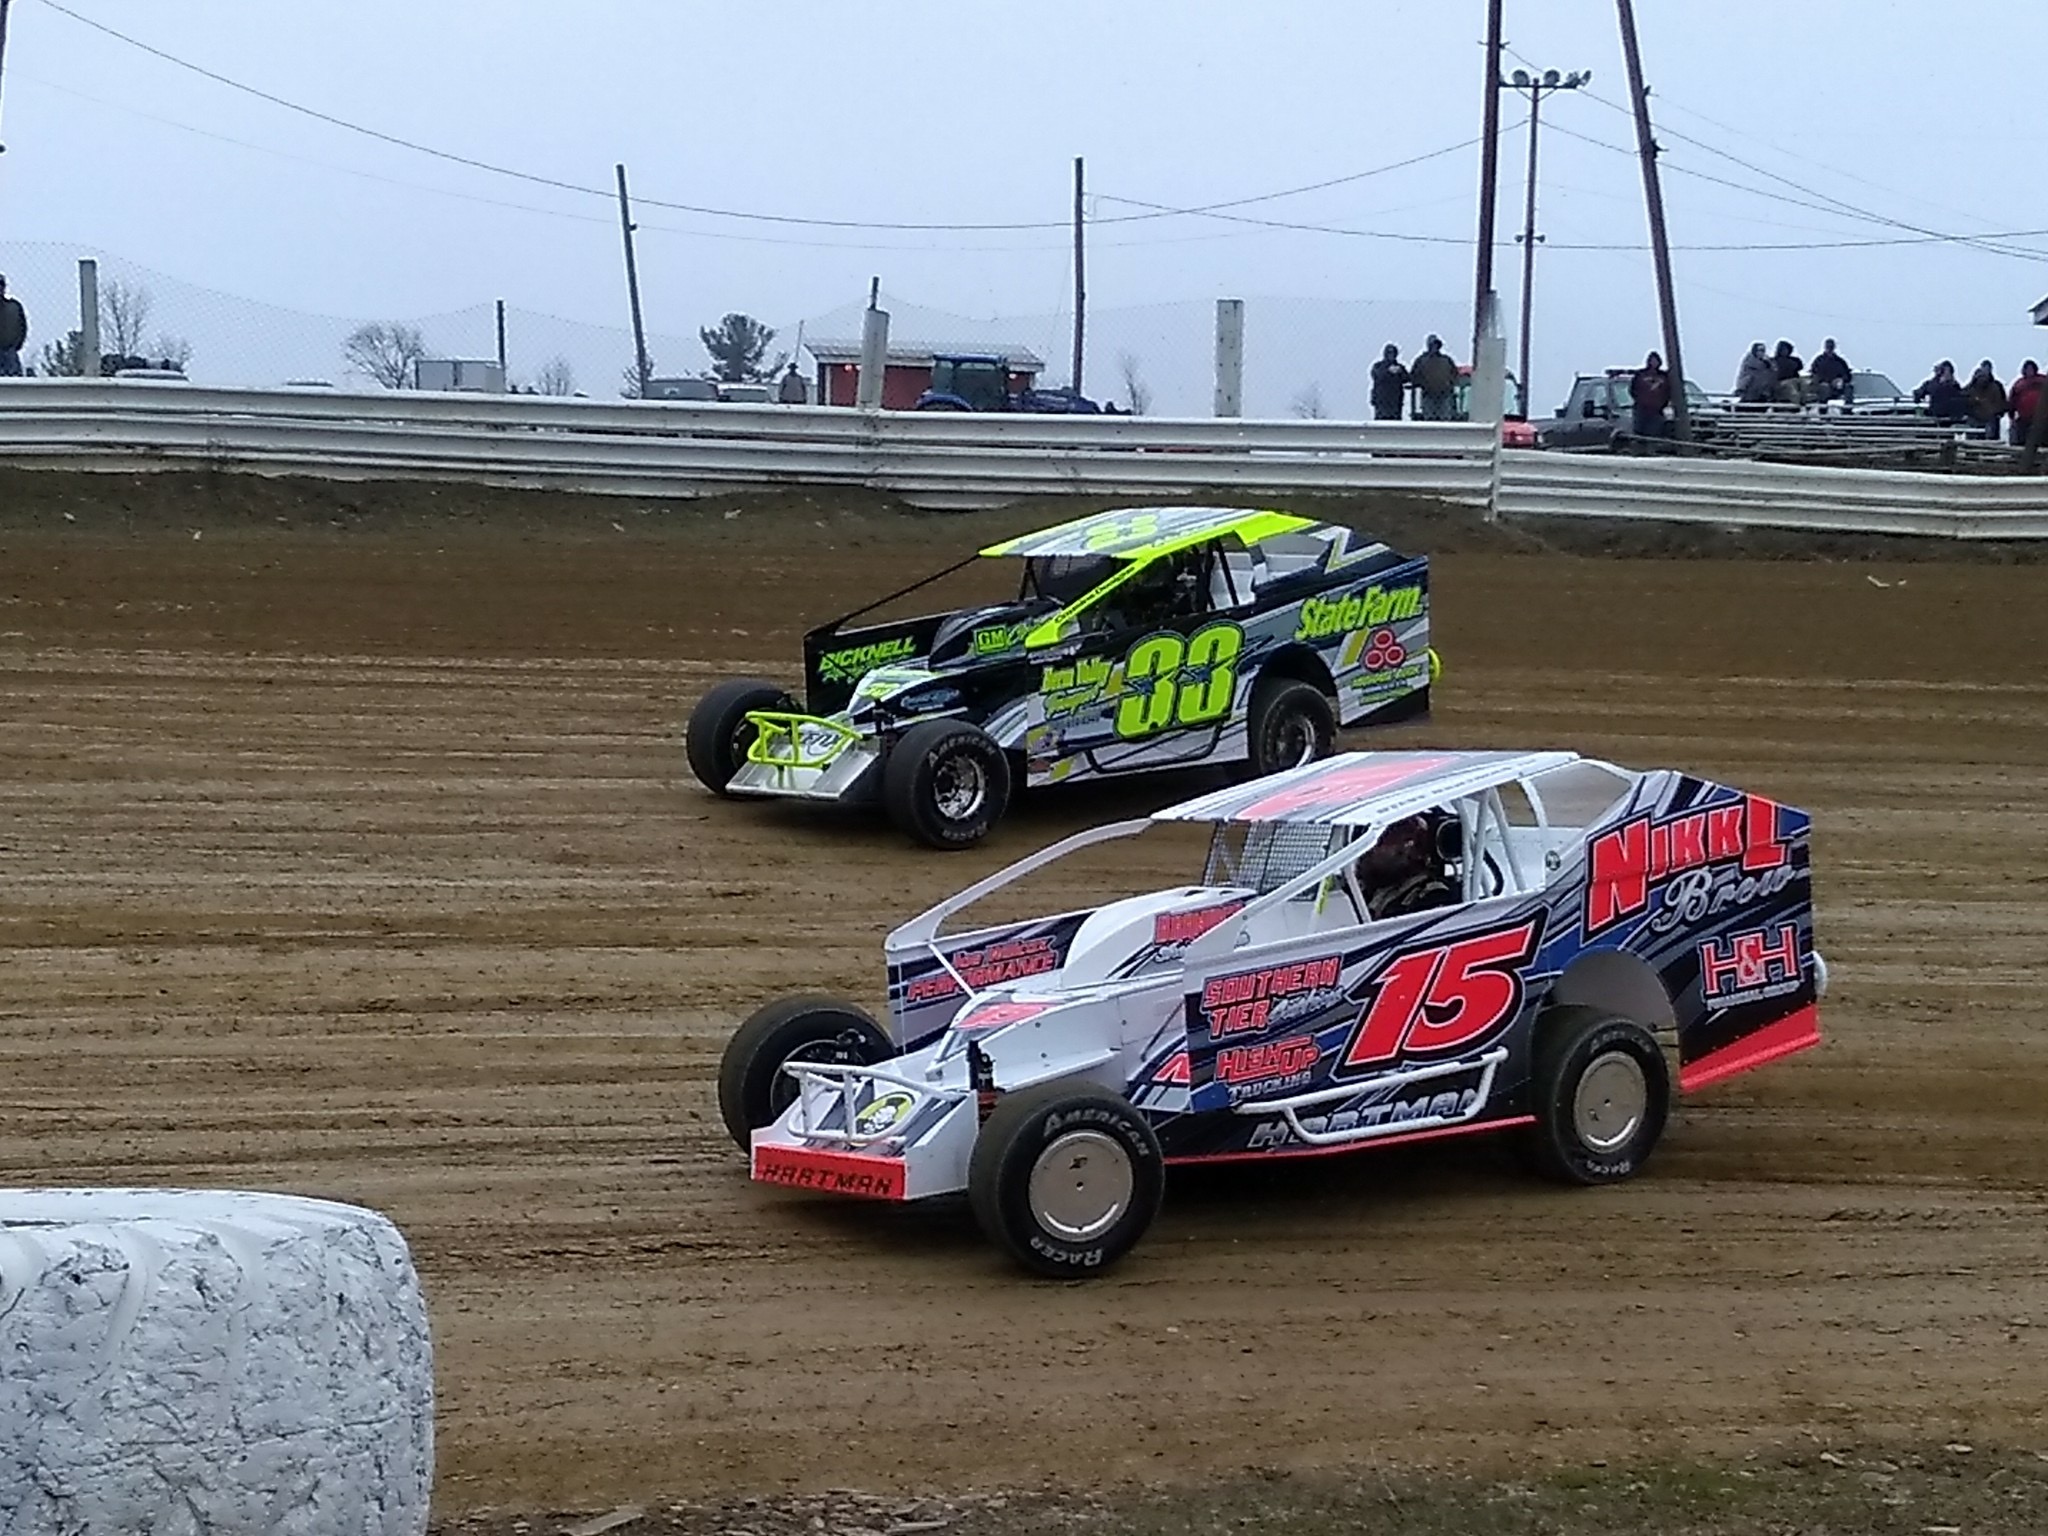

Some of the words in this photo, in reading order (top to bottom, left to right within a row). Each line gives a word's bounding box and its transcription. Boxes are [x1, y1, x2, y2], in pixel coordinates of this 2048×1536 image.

[976, 630, 1005, 651] GM
[1115, 622, 1244, 738] 33
[1651, 864, 1795, 932] Brew
[1202, 956, 1339, 1008] SOUTHERN
[1701, 925, 1798, 995] H&H
[1211, 1000, 1271, 1037] TIER
[1345, 920, 1535, 1066] 15
[763, 1164, 892, 1195] HARTMAN
